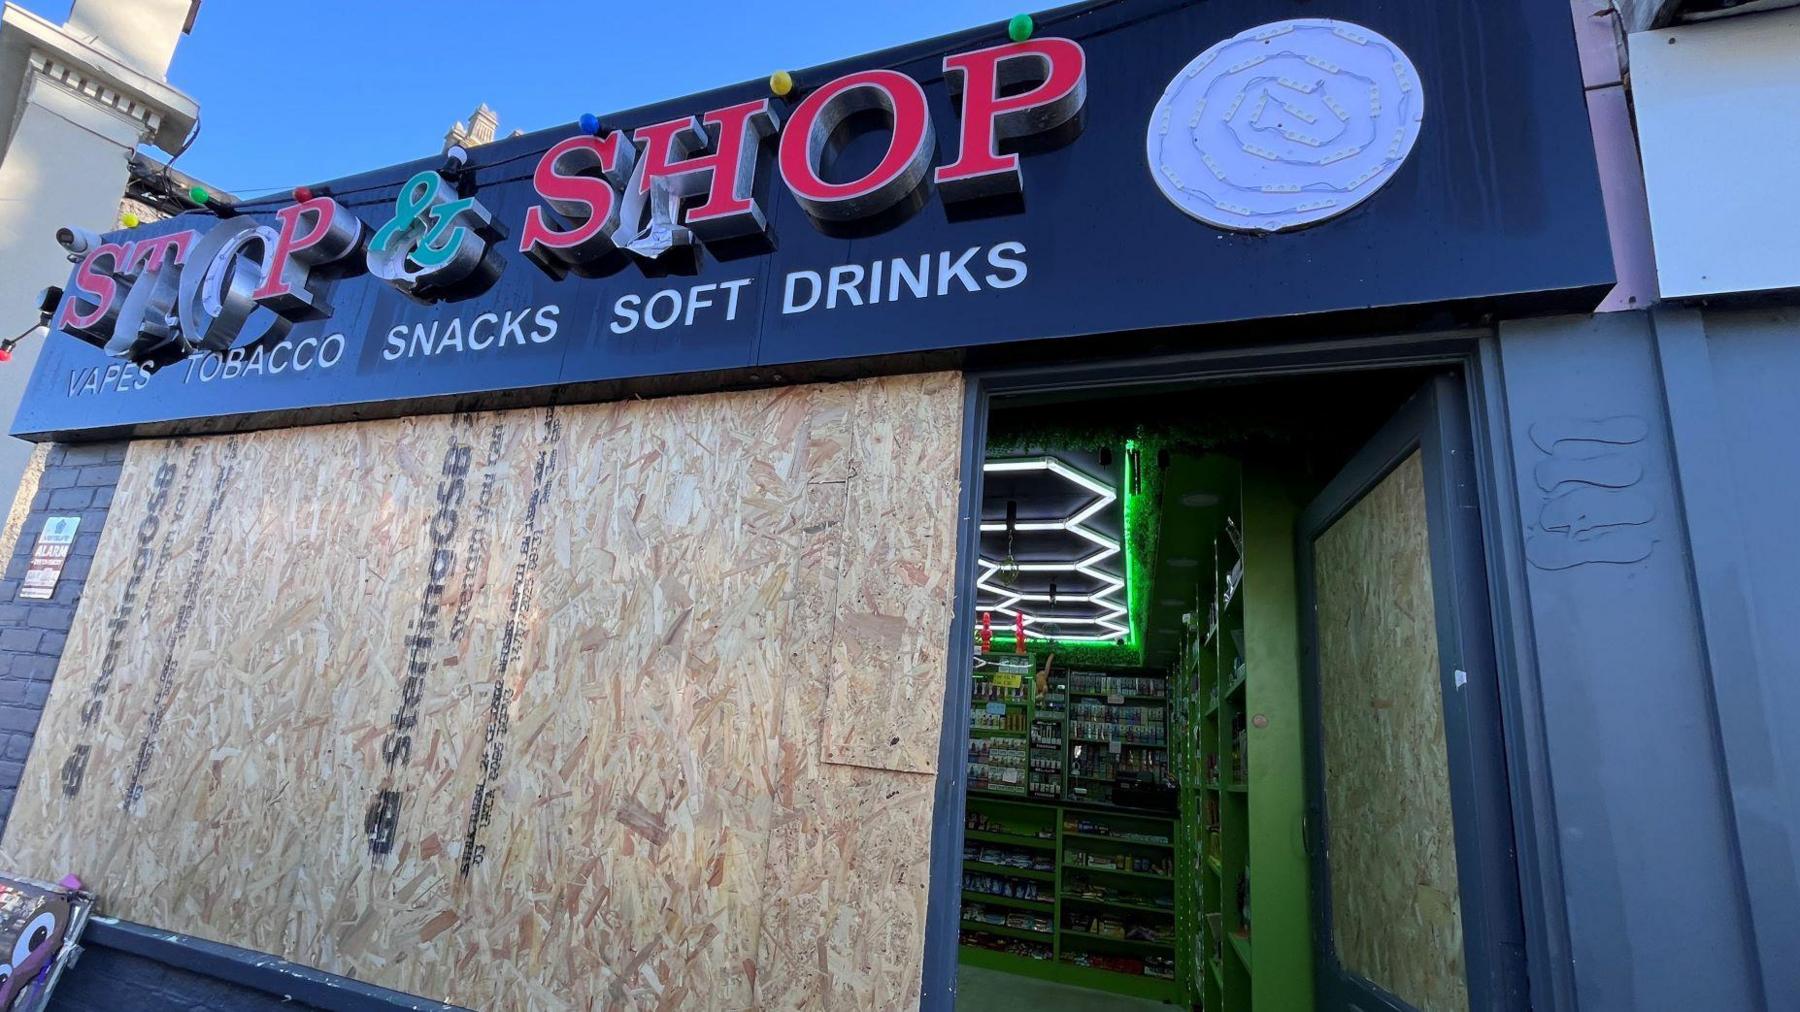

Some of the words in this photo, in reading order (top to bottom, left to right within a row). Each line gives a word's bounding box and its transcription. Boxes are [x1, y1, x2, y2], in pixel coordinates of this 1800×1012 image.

[59, 196, 361, 356] STOP
[366, 170, 486, 282] &
[519, 37, 1088, 264] SHOP
[66, 359, 155, 398] VAPES
[182, 333, 345, 385] TOBACCO
[383, 304, 560, 361] SNACKS
[610, 277, 755, 335] SOFT
[782, 241, 1029, 315] DRINKS
[34, 544, 69, 558] ALARM
